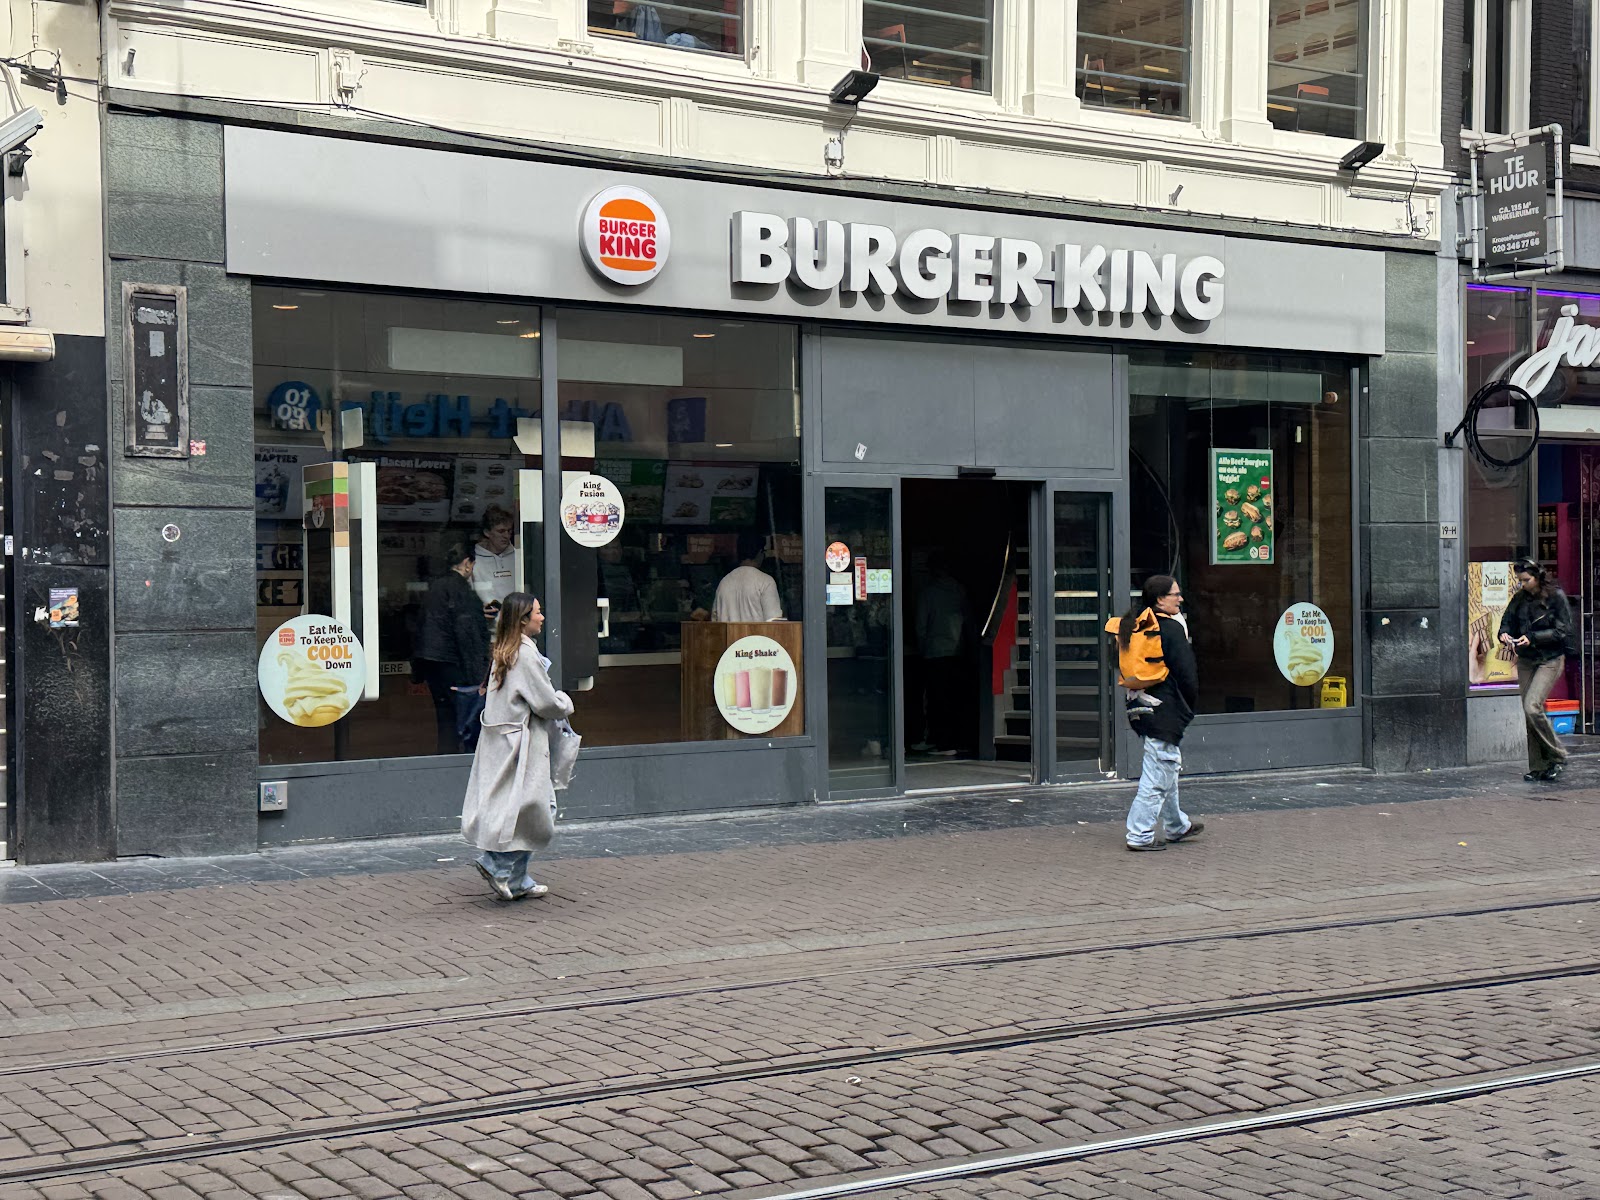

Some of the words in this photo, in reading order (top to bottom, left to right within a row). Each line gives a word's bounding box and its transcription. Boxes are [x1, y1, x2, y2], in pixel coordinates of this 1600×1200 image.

[1503, 155, 1525, 175] TE
[1490, 169, 1539, 195] HUUR
[599, 218, 657, 238] BURGER
[599, 234, 657, 259] KING
[1492, 244, 1506, 254] 020
[732, 210, 1044, 308] BURGER
[1055, 243, 1225, 321] KING
[1508, 304, 1600, 400] ja
[583, 481, 601, 491] King
[579, 490, 605, 499] Fusion
[308, 625, 326, 635] Eat
[328, 625, 343, 635] Me
[1300, 626, 1327, 637] COOL
[300, 636, 313, 645] To
[313, 635, 336, 647] Keep
[336, 634, 354, 644] You
[307, 645, 353, 661] COOL
[735, 650, 754, 660] King
[754, 649, 778, 658] Shake
[325, 660, 352, 671] Down
